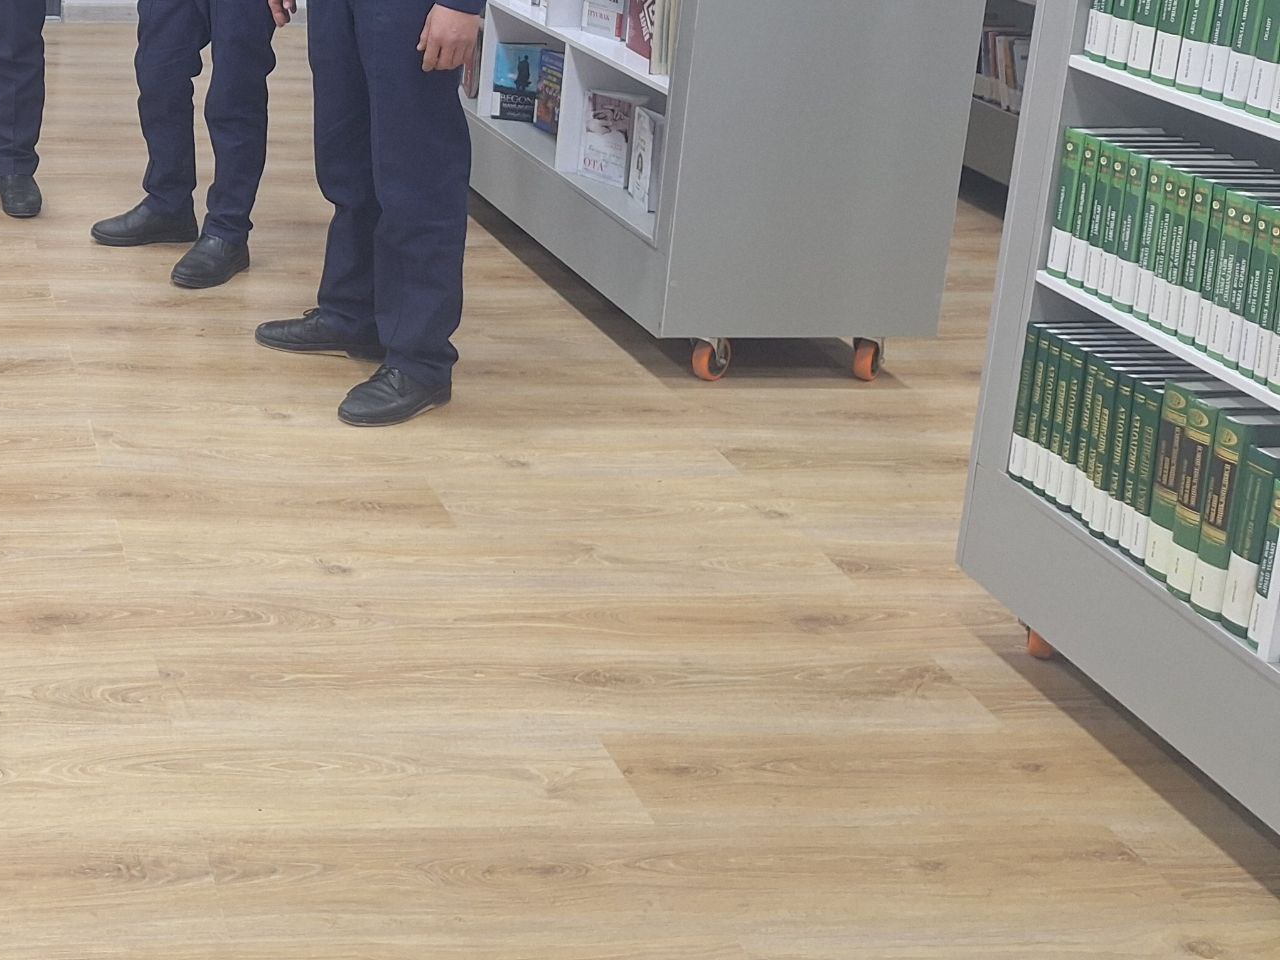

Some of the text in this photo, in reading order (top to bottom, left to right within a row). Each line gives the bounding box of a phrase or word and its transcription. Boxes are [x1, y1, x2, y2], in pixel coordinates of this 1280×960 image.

[1066, 377, 1078, 434] MIRZIYOYEV
[1112, 405, 1127, 465] MIRZIYOYEV
[1128, 413, 1141, 474] MIRZIYOYEV
